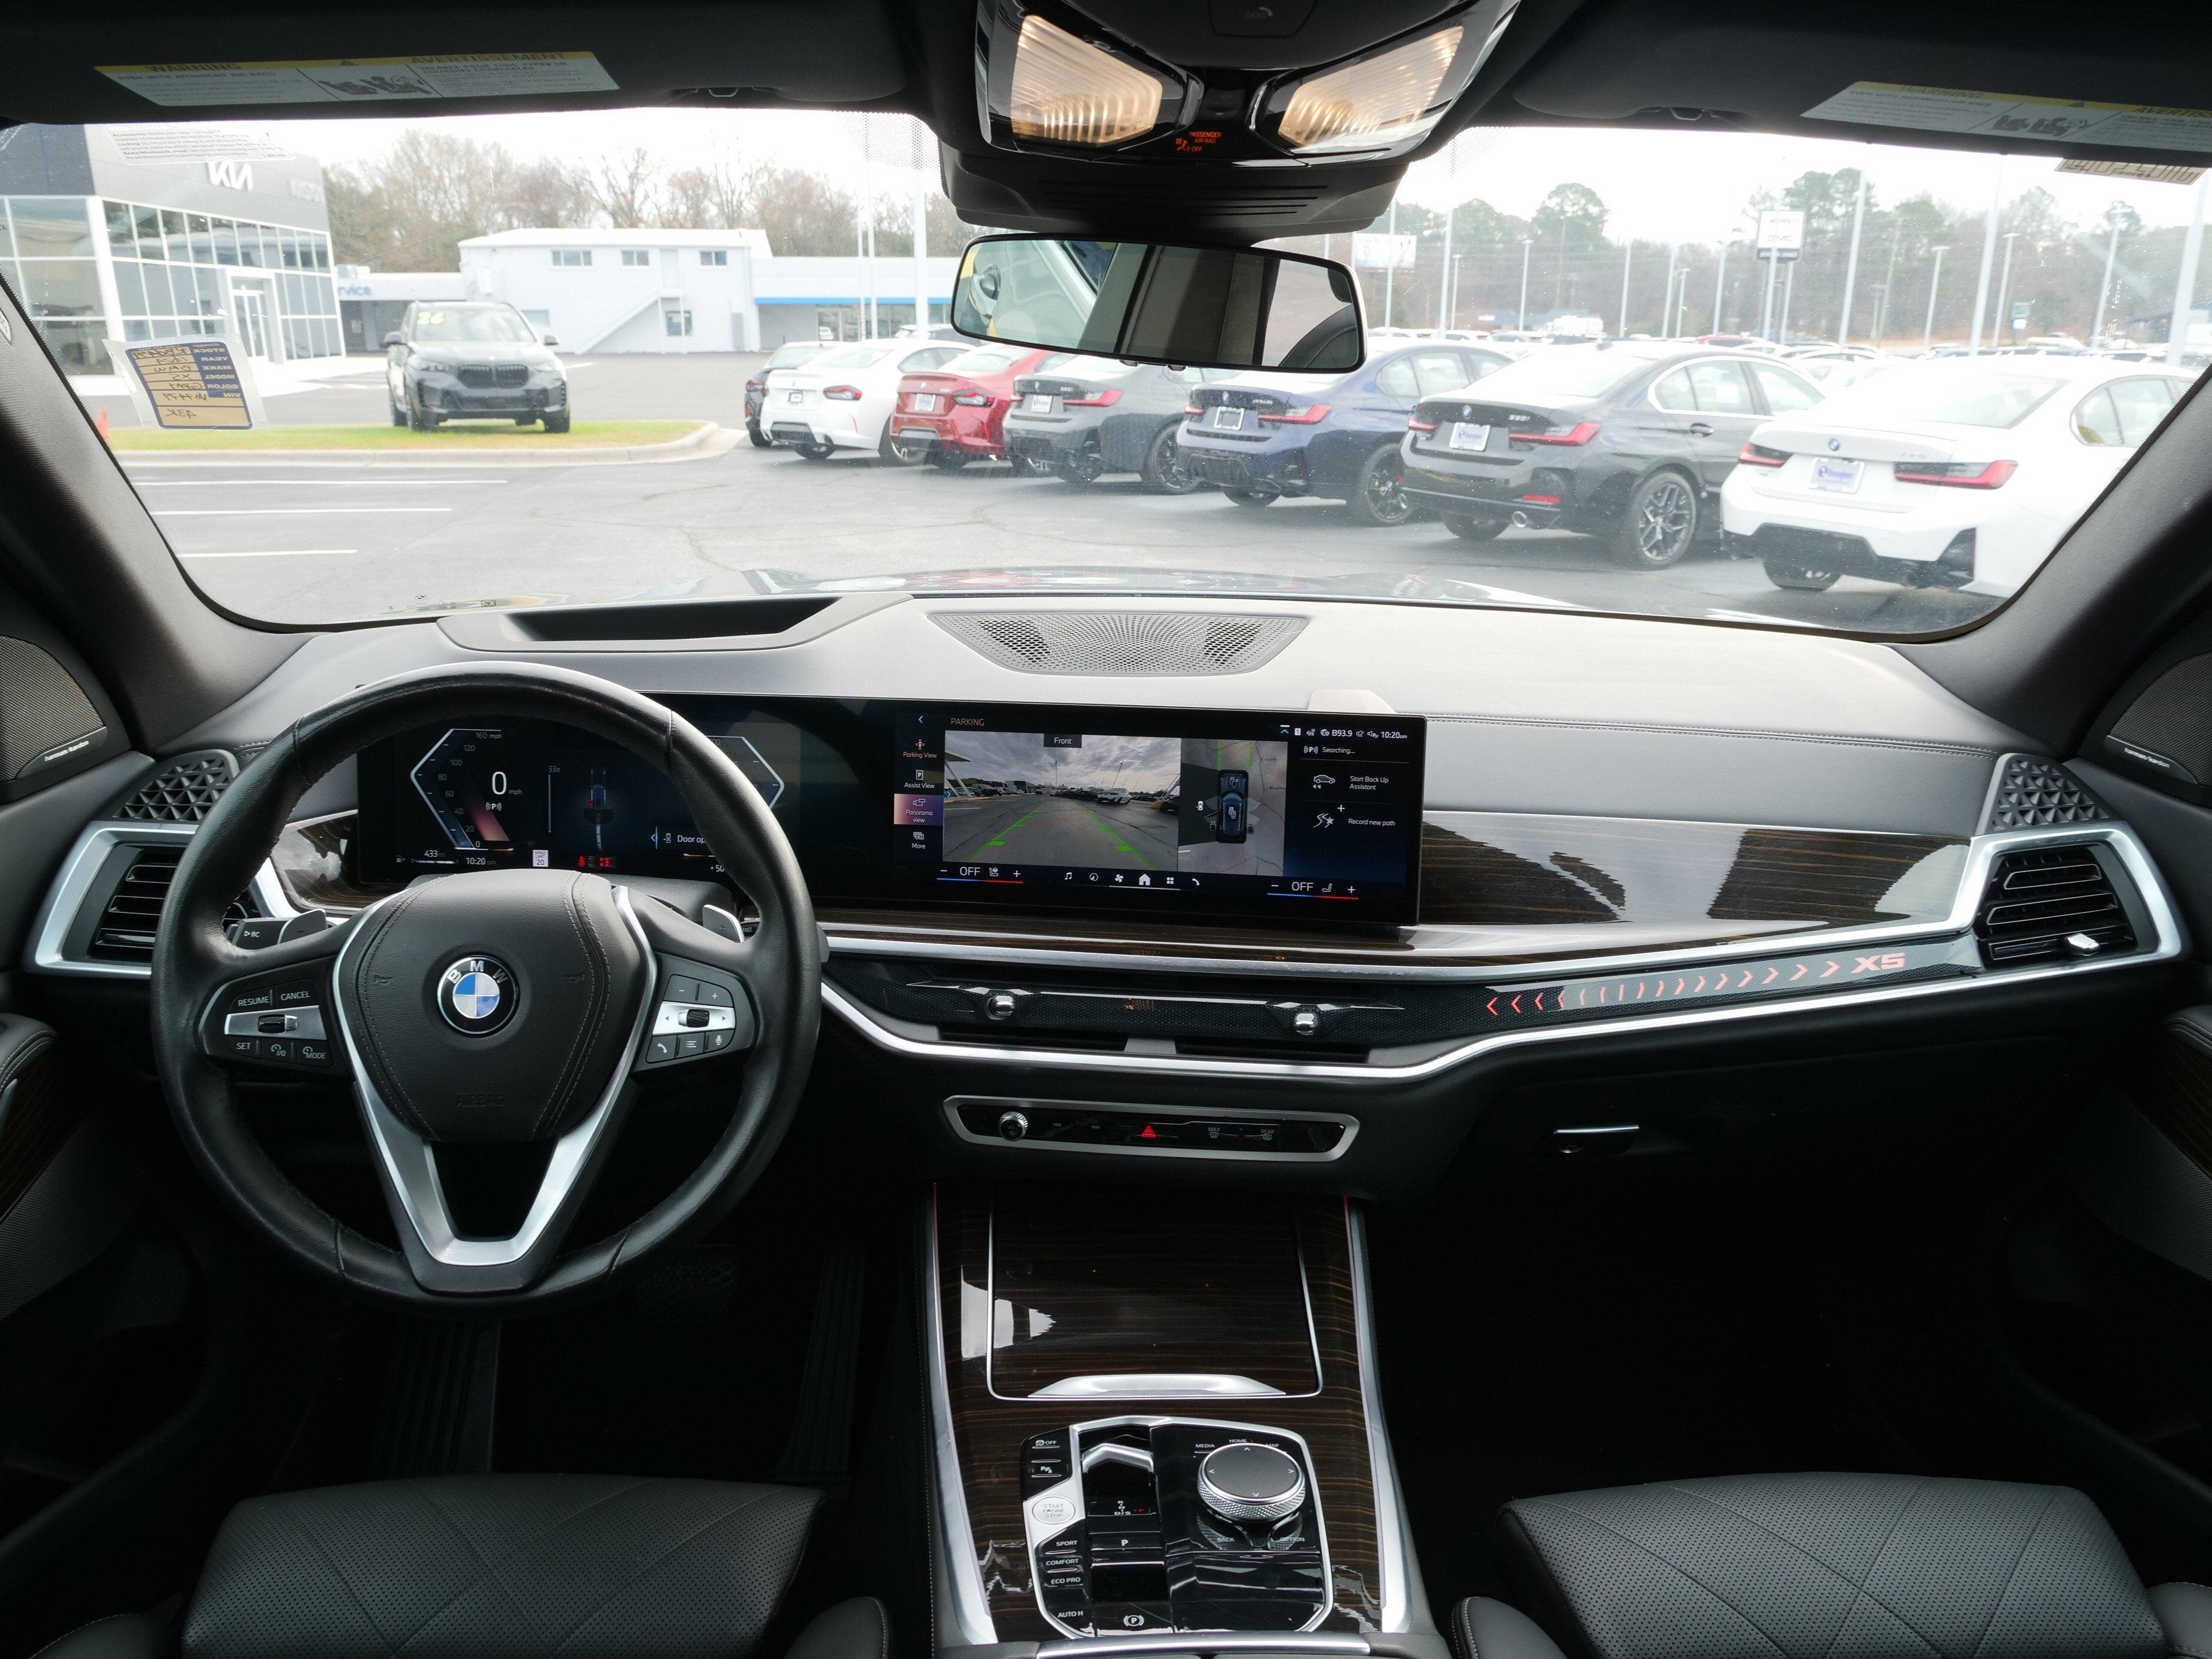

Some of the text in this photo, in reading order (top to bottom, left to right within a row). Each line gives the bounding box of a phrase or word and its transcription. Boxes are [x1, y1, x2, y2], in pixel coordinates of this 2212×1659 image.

[145, 62, 243, 72] WARNING
[950, 717, 984, 726] PARKING
[1054, 737, 1072, 745] Front
[492, 771, 507, 795] 0
[959, 866, 981, 876] OFF
[1291, 881, 1314, 891] OFF
[1851, 952, 1906, 974] X5
[447, 960, 509, 984] BMW
[238, 996, 270, 1006] RESUME
[280, 991, 311, 1001] CANCEL
[305, 1051, 327, 1060] MODE
[456, 1092, 504, 1107] AIRBAG
